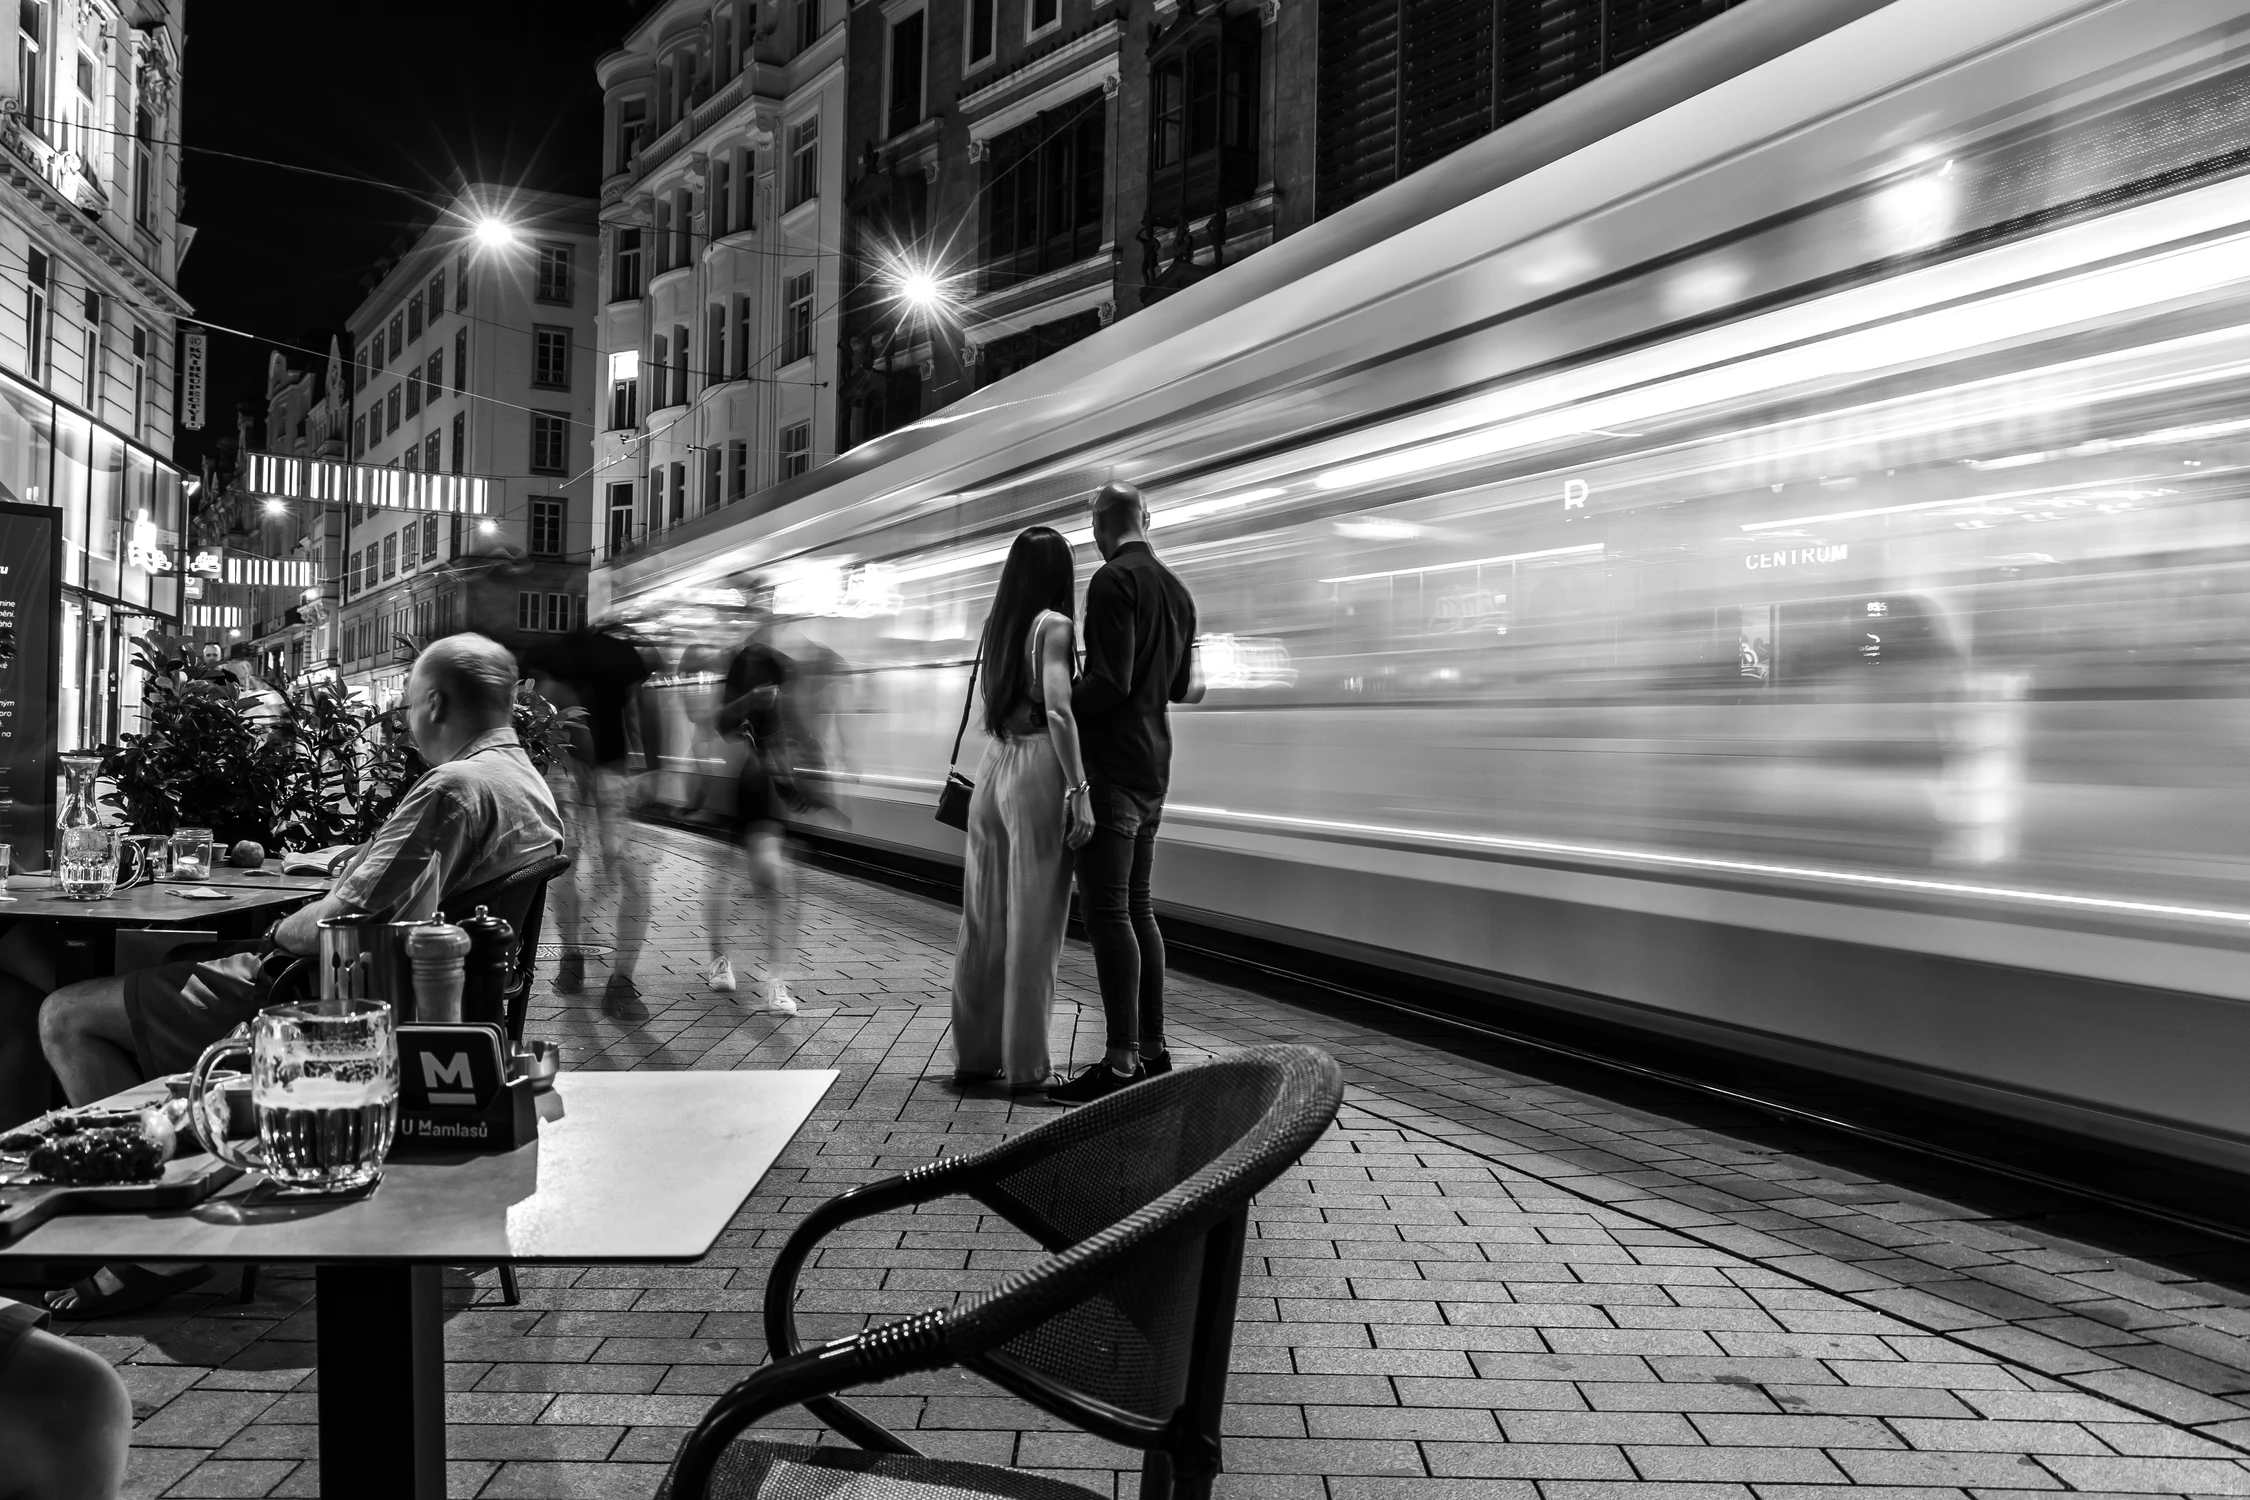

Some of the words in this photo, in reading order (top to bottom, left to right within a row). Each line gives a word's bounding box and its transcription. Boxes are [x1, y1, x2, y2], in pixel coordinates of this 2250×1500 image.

[1745, 543, 1848, 570] CENTRUM
[419, 1051, 474, 1089] M
[401, 1119, 414, 1135] U
[418, 1120, 488, 1138] Mamlasů
